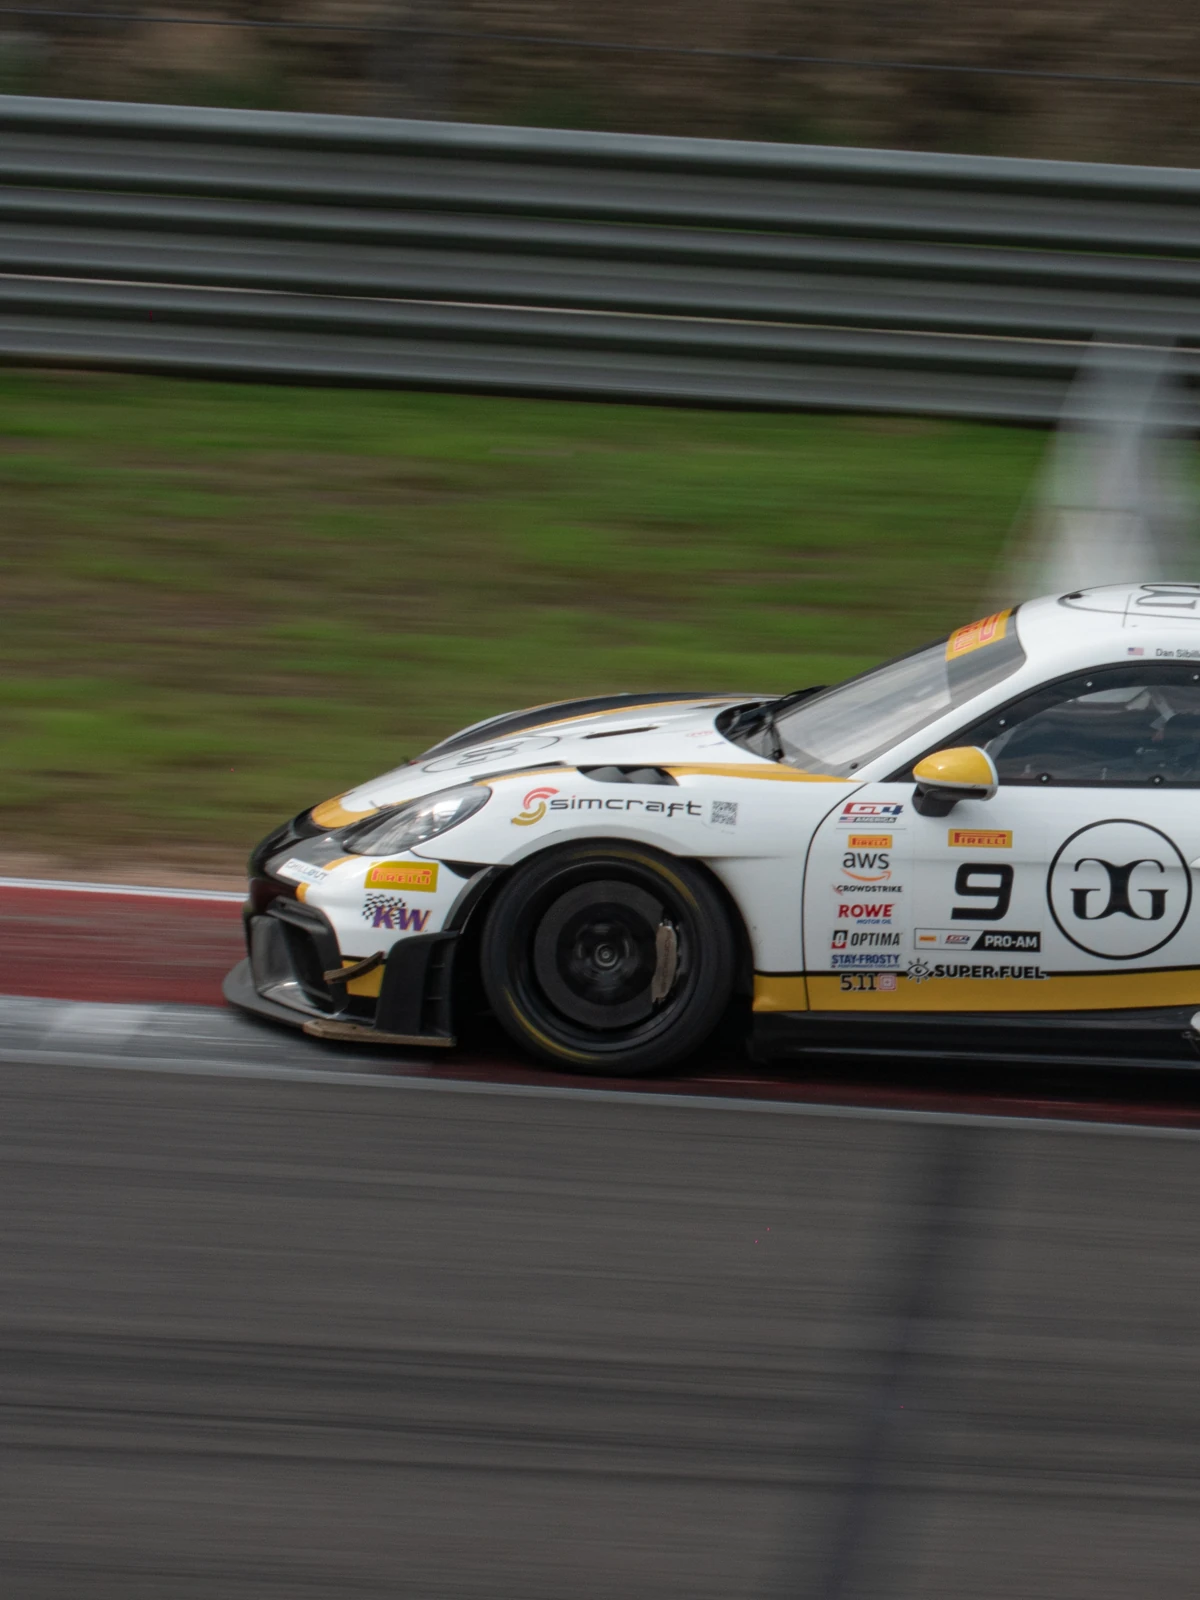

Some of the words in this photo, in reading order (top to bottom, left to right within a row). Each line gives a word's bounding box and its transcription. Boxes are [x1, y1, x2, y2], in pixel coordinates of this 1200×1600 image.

[1156, 648, 1174, 657] Dan
[549, 795, 702, 817] simcraft
[842, 802, 904, 815] GT4
[851, 837, 889, 846] PIRELLI
[953, 832, 1007, 845] PIRELLI
[842, 851, 890, 870] aws
[371, 868, 432, 885] PIRELLI
[836, 885, 903, 893] CROWDSTRIKE
[951, 862, 1015, 921] 9
[838, 903, 895, 918] ROWE
[371, 906, 431, 932] KW
[850, 932, 901, 946] OPTIMA
[984, 935, 1037, 948] PRO-AM
[831, 954, 901, 965] STAY-FROSTY
[934, 965, 995, 978] SUPER
[999, 966, 1046, 979] FUEL
[840, 973, 877, 991] 5.11
